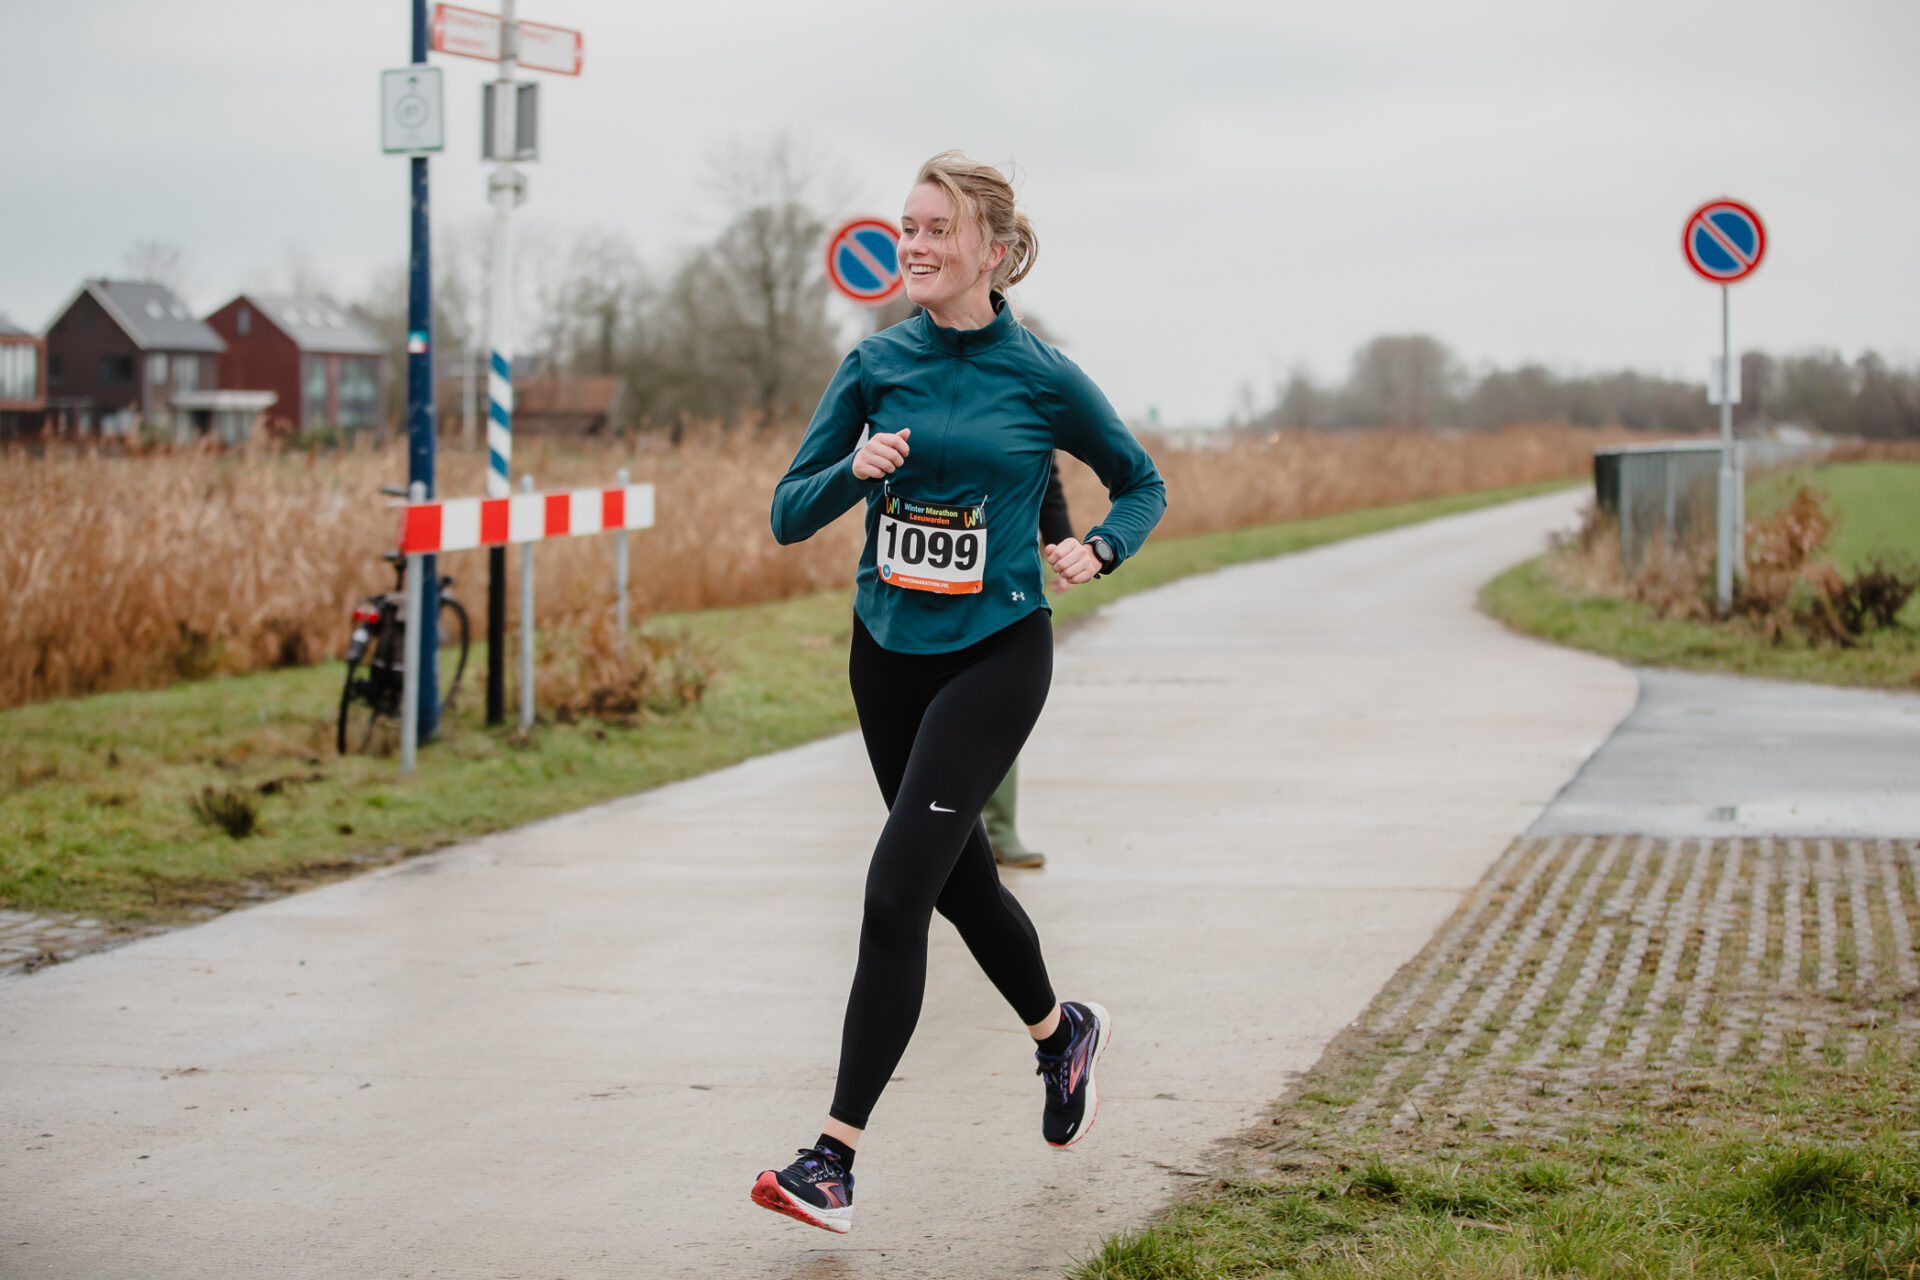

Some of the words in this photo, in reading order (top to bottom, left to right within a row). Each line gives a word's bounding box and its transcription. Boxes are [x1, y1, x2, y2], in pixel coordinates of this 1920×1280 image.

[904, 503, 925, 513] Winter
[925, 507, 958, 517] Marathon
[909, 512, 949, 525] Leeuwarden
[885, 522, 978, 570] 1099
